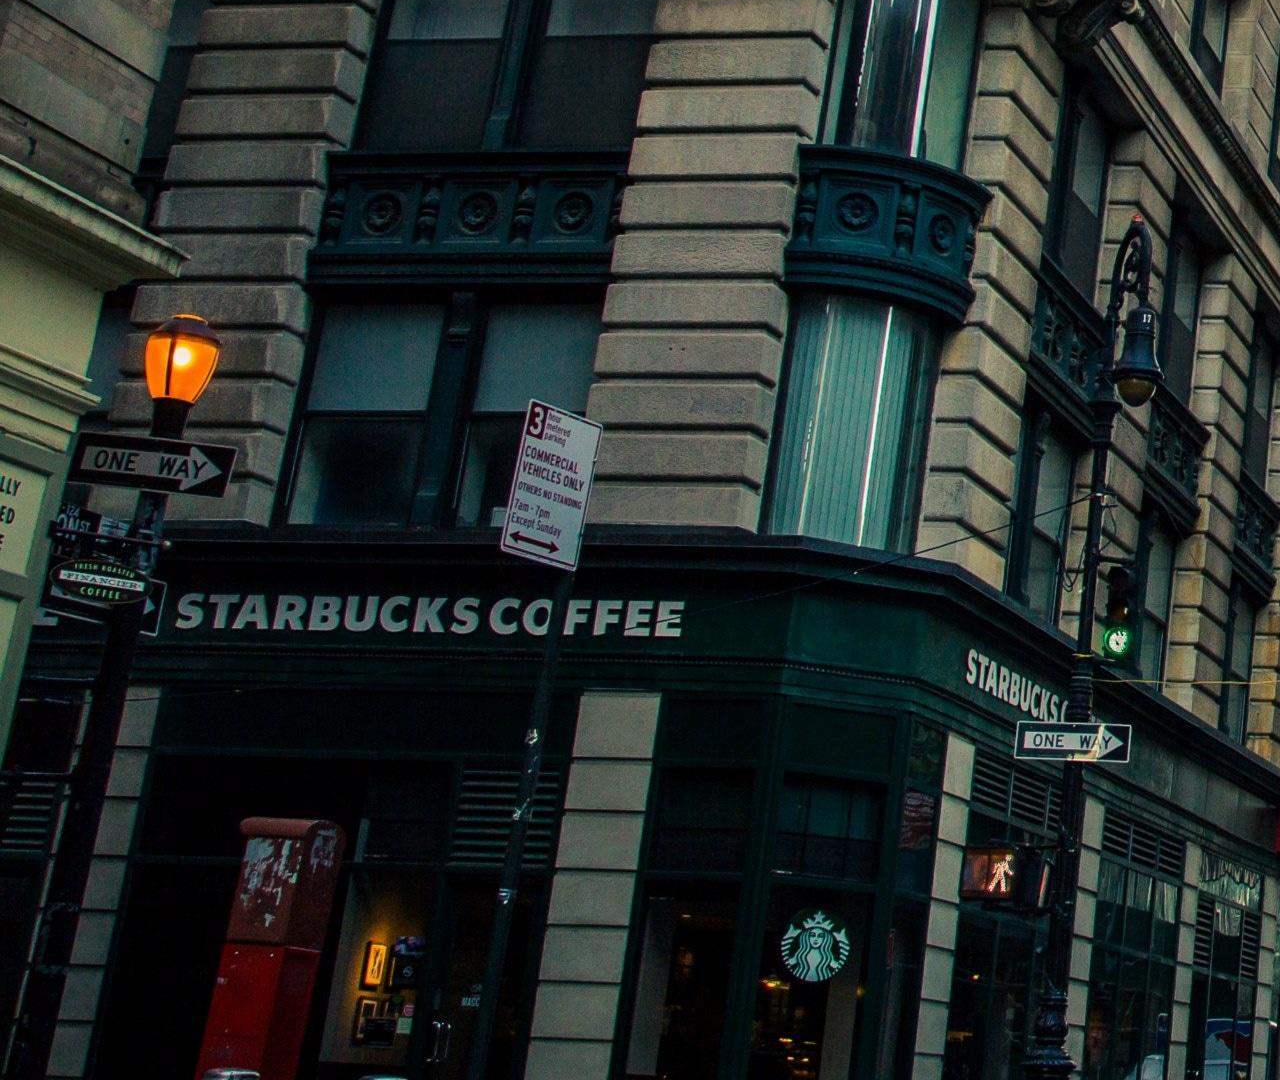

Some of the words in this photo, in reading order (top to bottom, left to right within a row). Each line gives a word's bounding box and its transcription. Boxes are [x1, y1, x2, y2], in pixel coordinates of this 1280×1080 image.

[530, 406, 545, 436] 3
[546, 423, 572, 438] metered
[543, 431, 567, 448] parking
[94, 449, 140, 471] ONE
[159, 454, 208, 480] WAY
[525, 445, 579, 475] COMMERCIAL
[522, 461, 562, 485] VEHICLES
[563, 474, 585, 493] ONLY
[514, 497, 530, 513] 7am
[535, 504, 551, 520] 7pm
[517, 480, 542, 497] OTHERS
[542, 488, 552, 500] NO
[551, 492, 582, 511] STANDING
[511, 513, 536, 530] Except
[536, 520, 562, 540] Sunday
[66, 571, 141, 589] FINANCIER
[74, 560, 99, 570] FRESH
[101, 564, 136, 579] ROASTED
[80, 586, 121, 600] COFFEE
[174, 592, 481, 634] STARBUCKS
[488, 598, 687, 638] COFFEE
[966, 648, 1059, 722] STARBUCKS
[1033, 733, 1064, 748] ONE
[1079, 734, 1112, 750] WAY
